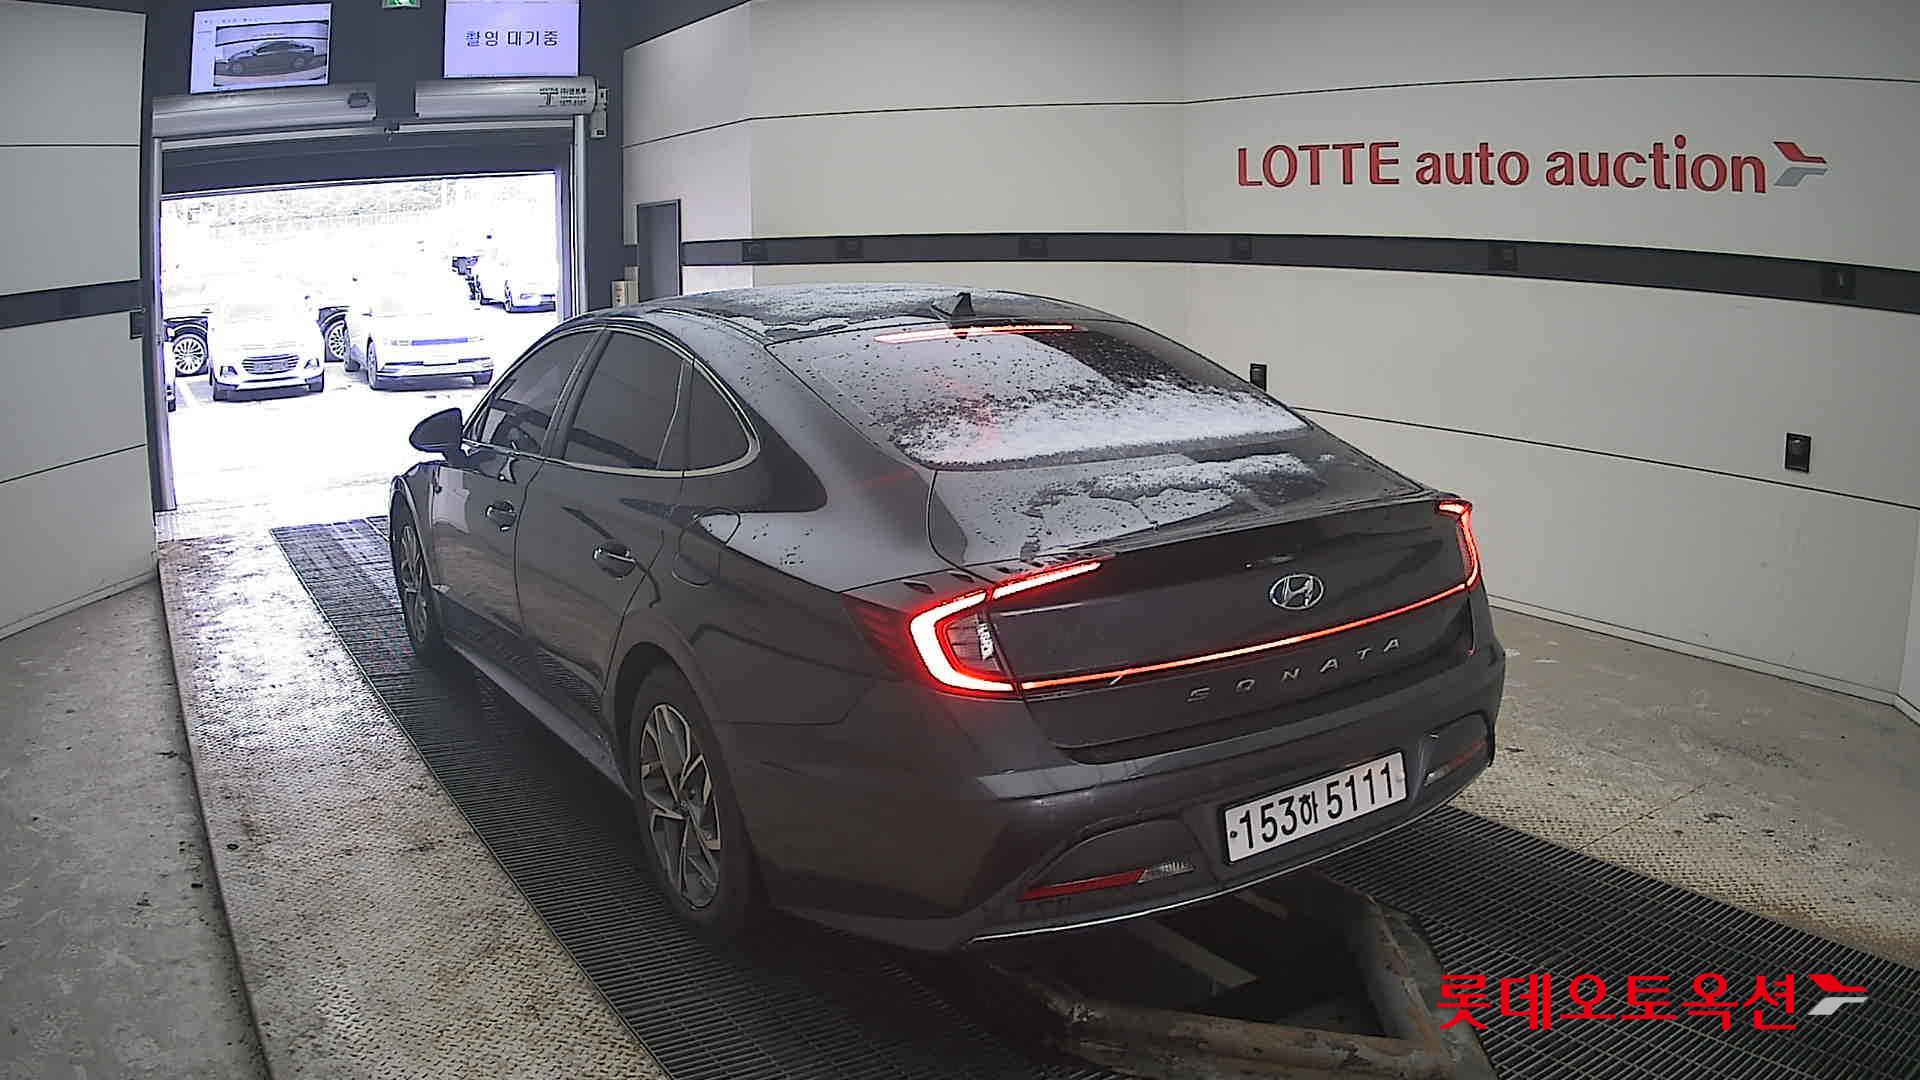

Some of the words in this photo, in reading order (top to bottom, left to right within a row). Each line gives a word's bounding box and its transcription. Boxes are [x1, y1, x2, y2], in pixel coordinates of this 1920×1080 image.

[464, 31, 499, 46] 촬영
[507, 31, 559, 46] 대기중
[1237, 142, 1400, 188] LOTTE
[1415, 142, 1530, 186] auto
[1545, 134, 1767, 194] auction
[1187, 638, 1400, 702] SONATA
